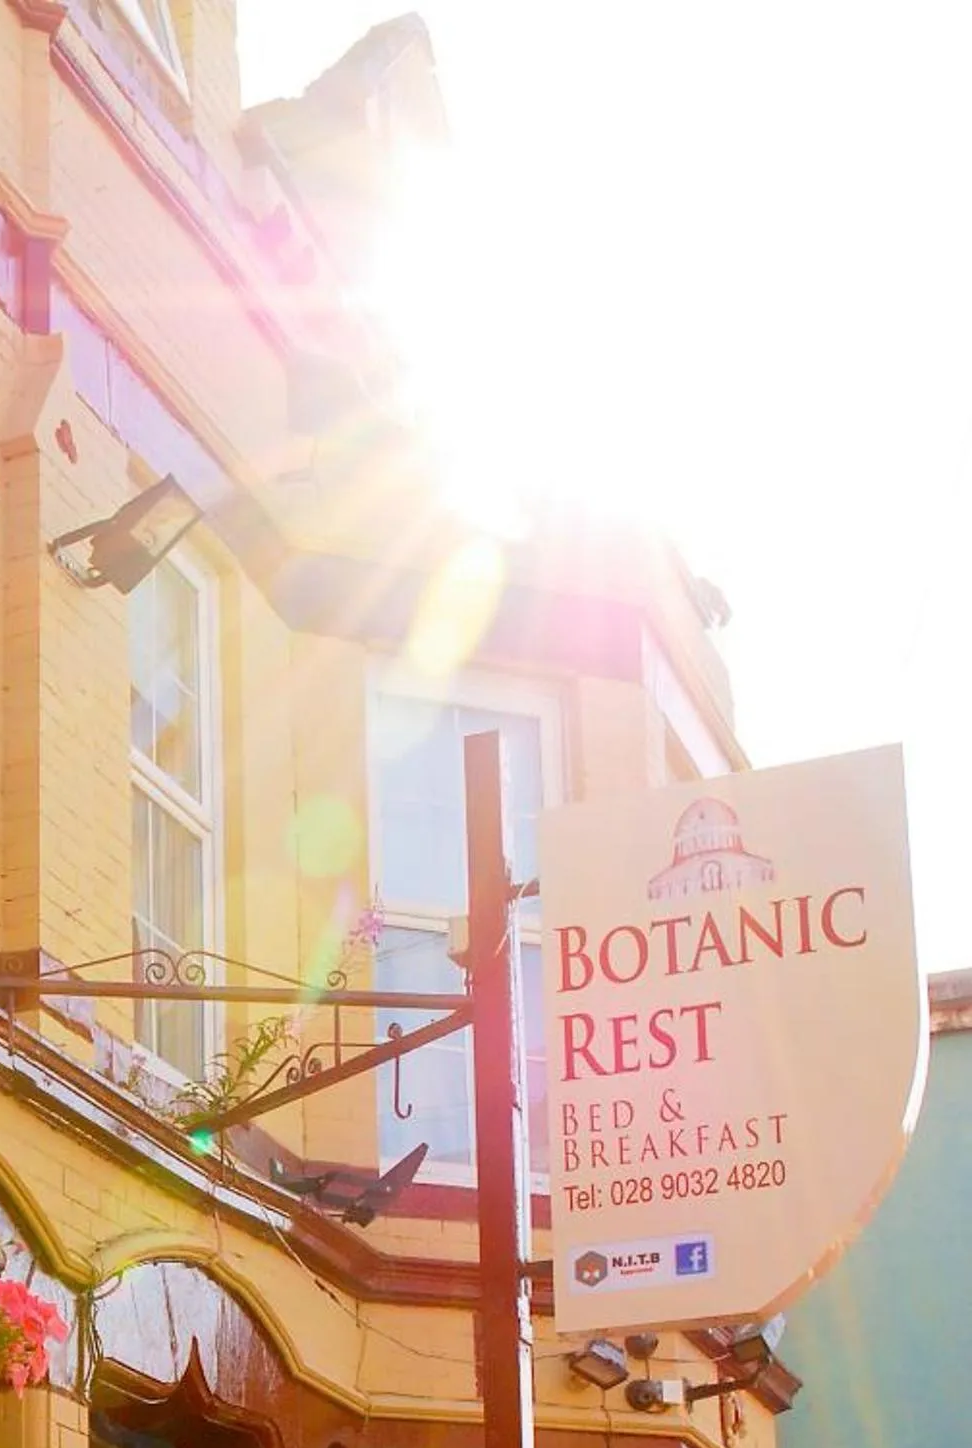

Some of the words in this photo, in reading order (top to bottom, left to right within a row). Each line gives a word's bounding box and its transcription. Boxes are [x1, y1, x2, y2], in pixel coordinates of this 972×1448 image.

[553, 887, 867, 993] BOTANIC
[558, 1001, 721, 1082] REST
[562, 1099, 634, 1136] BED
[659, 1088, 685, 1122] &
[563, 1114, 788, 1172] BREAKFAST
[564, 1184, 603, 1211] Tel:
[610, 1177, 653, 1206] 028
[660, 1168, 719, 1200] 9032
[726, 1160, 786, 1191] 4820
[612, 1252, 660, 1268] N.I.T.B
